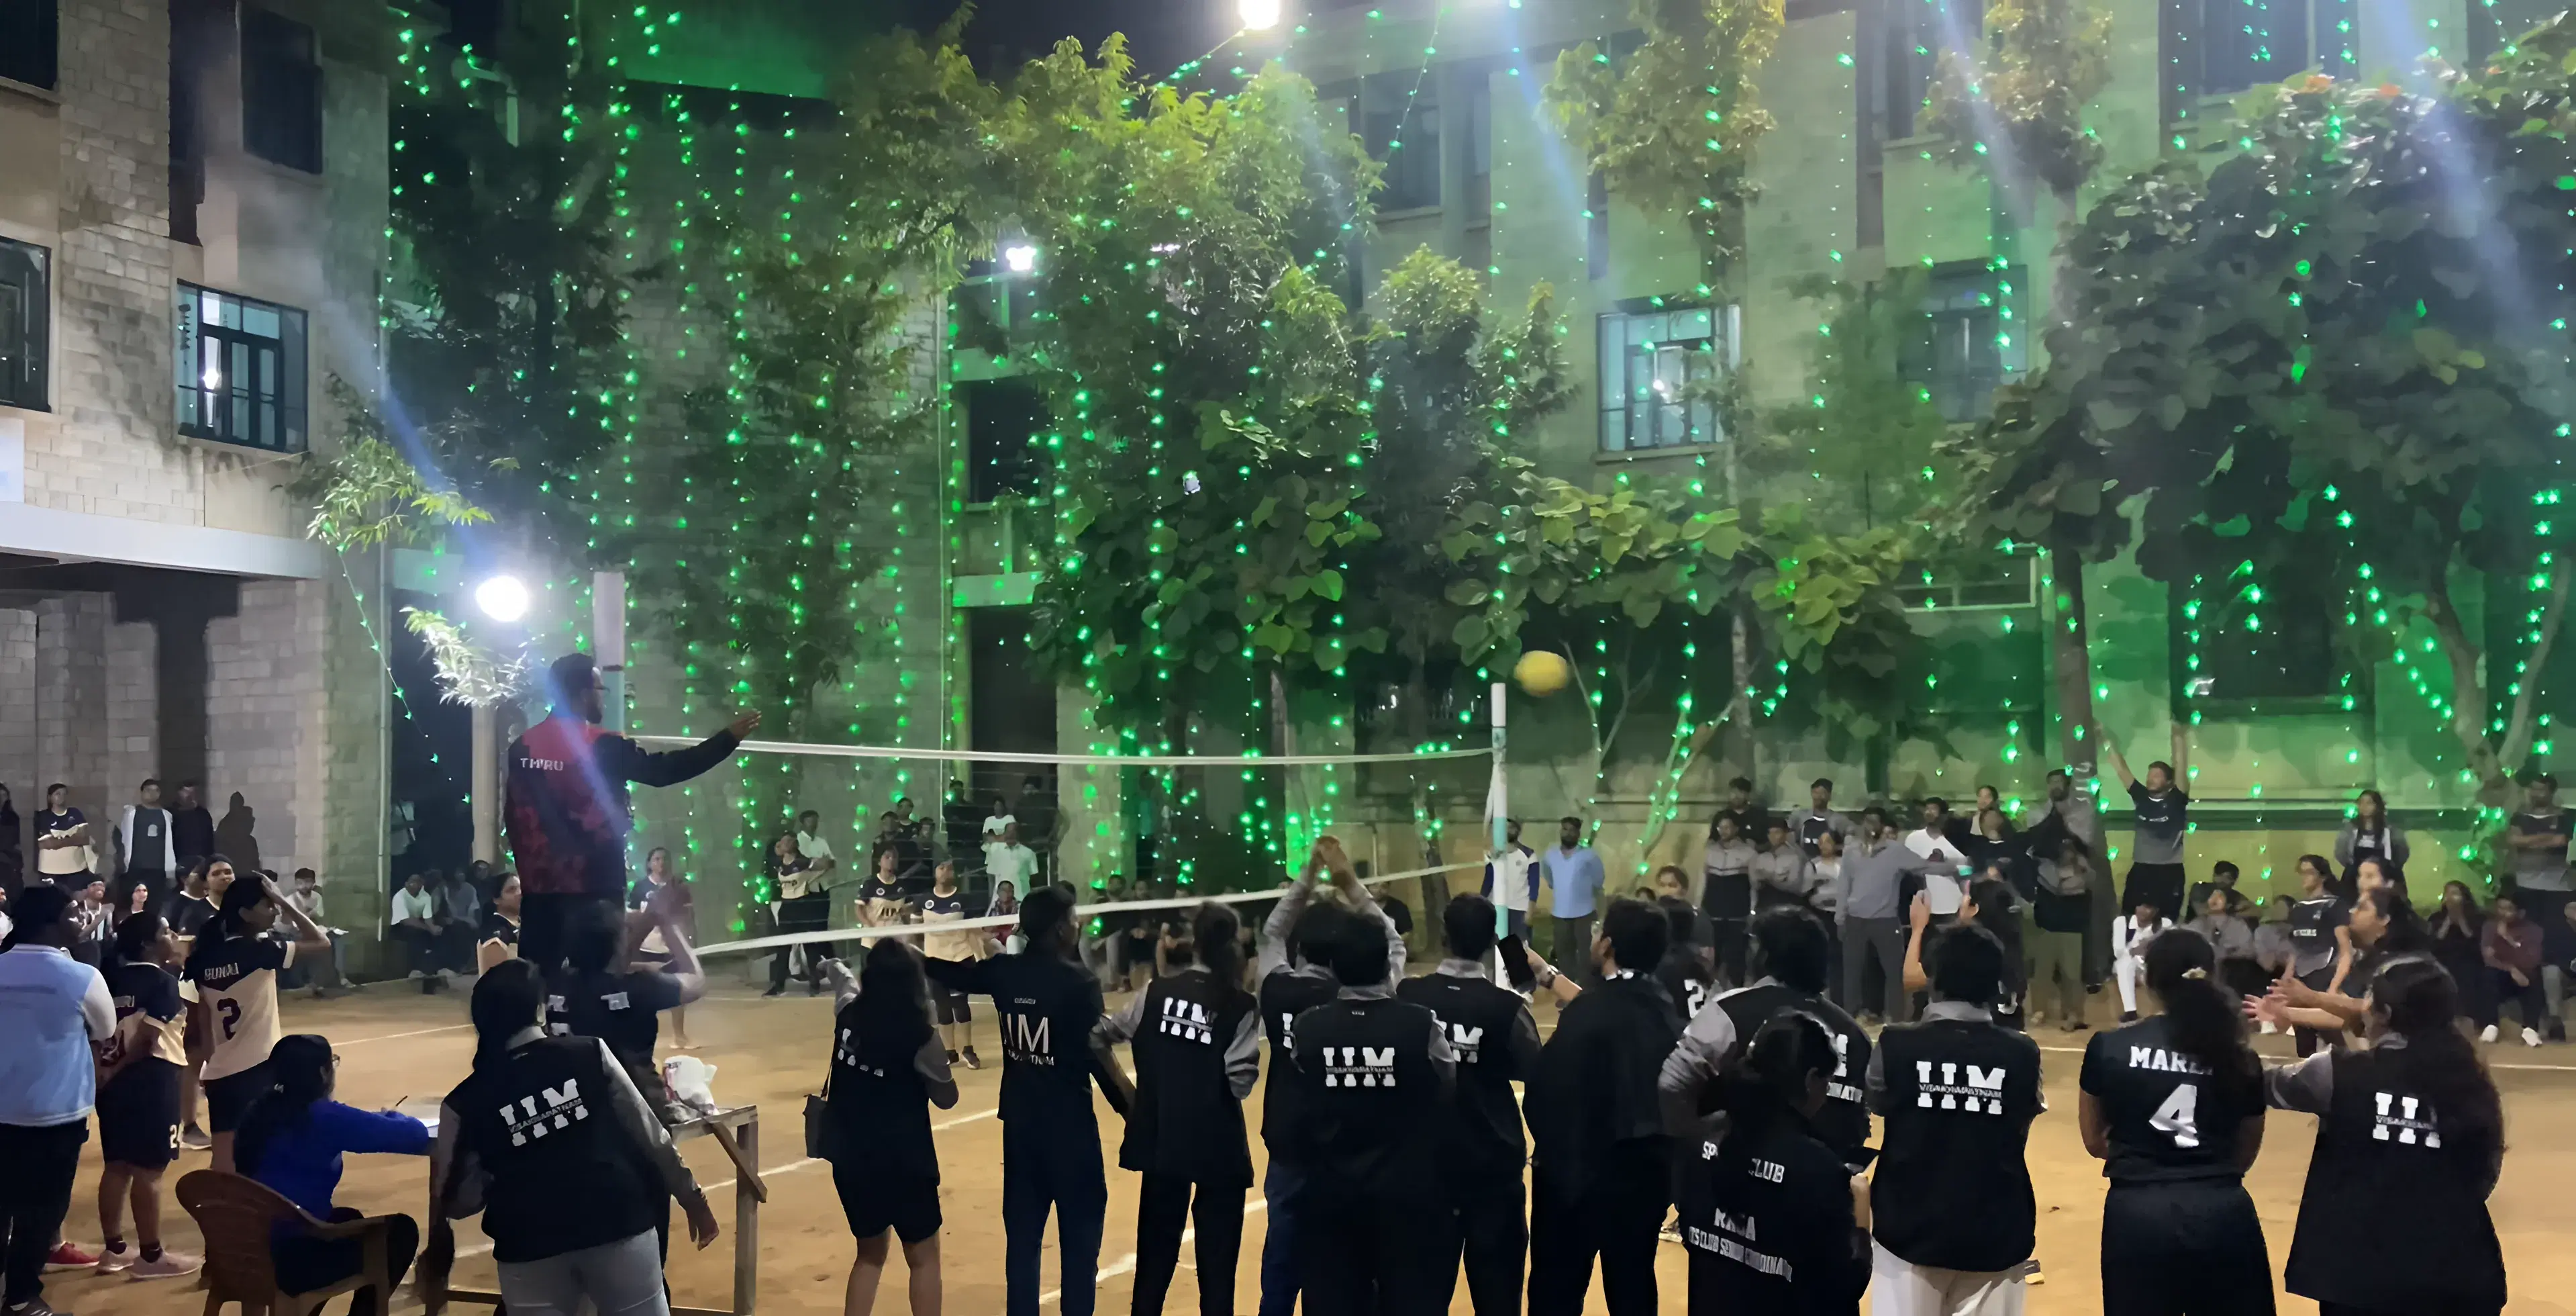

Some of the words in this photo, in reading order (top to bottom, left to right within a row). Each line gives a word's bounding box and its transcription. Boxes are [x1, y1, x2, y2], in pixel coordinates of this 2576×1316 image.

[216, 997, 242, 1041] 2
[1323, 1046, 1396, 1087] IIM
[1916, 1060, 2006, 1115] IIM
[499, 1078, 589, 1147] IIM
[2148, 1083, 2199, 1149] 4
